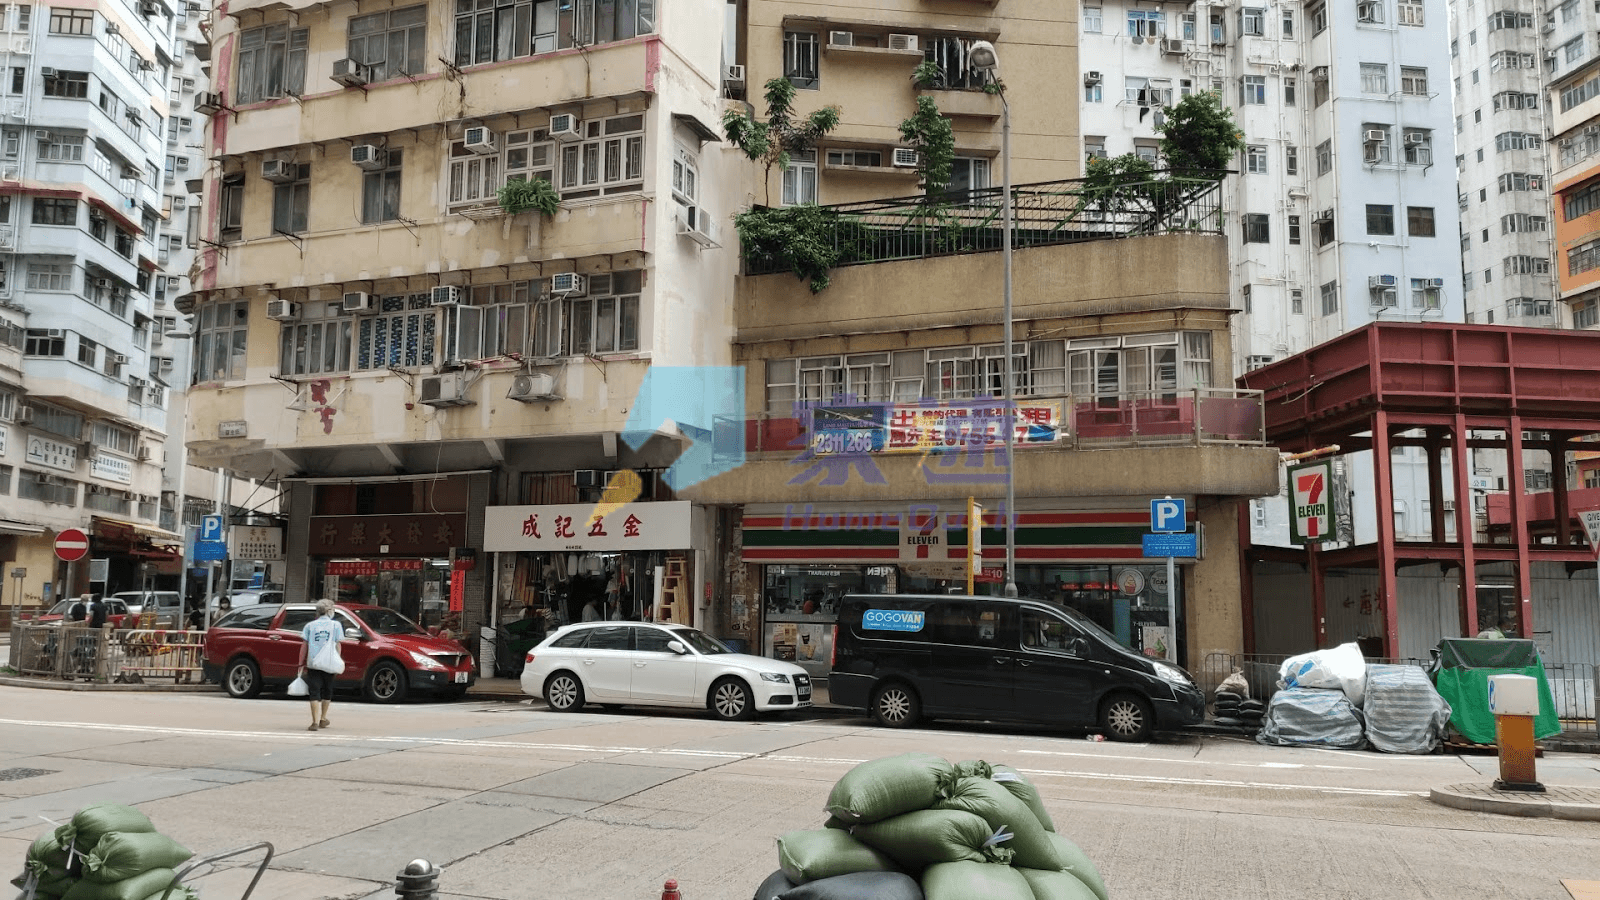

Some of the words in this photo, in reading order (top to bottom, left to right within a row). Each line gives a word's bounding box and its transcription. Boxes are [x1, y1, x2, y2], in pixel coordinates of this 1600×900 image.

[1157, 503, 1179, 529] P
[1587, 512, 1600, 521] GIVE
[204, 517, 219, 538] P
[521, 513, 643, 539] 成記五金
[1588, 522, 1600, 530] WAY
[866, 611, 922, 625] GOGOVAN
